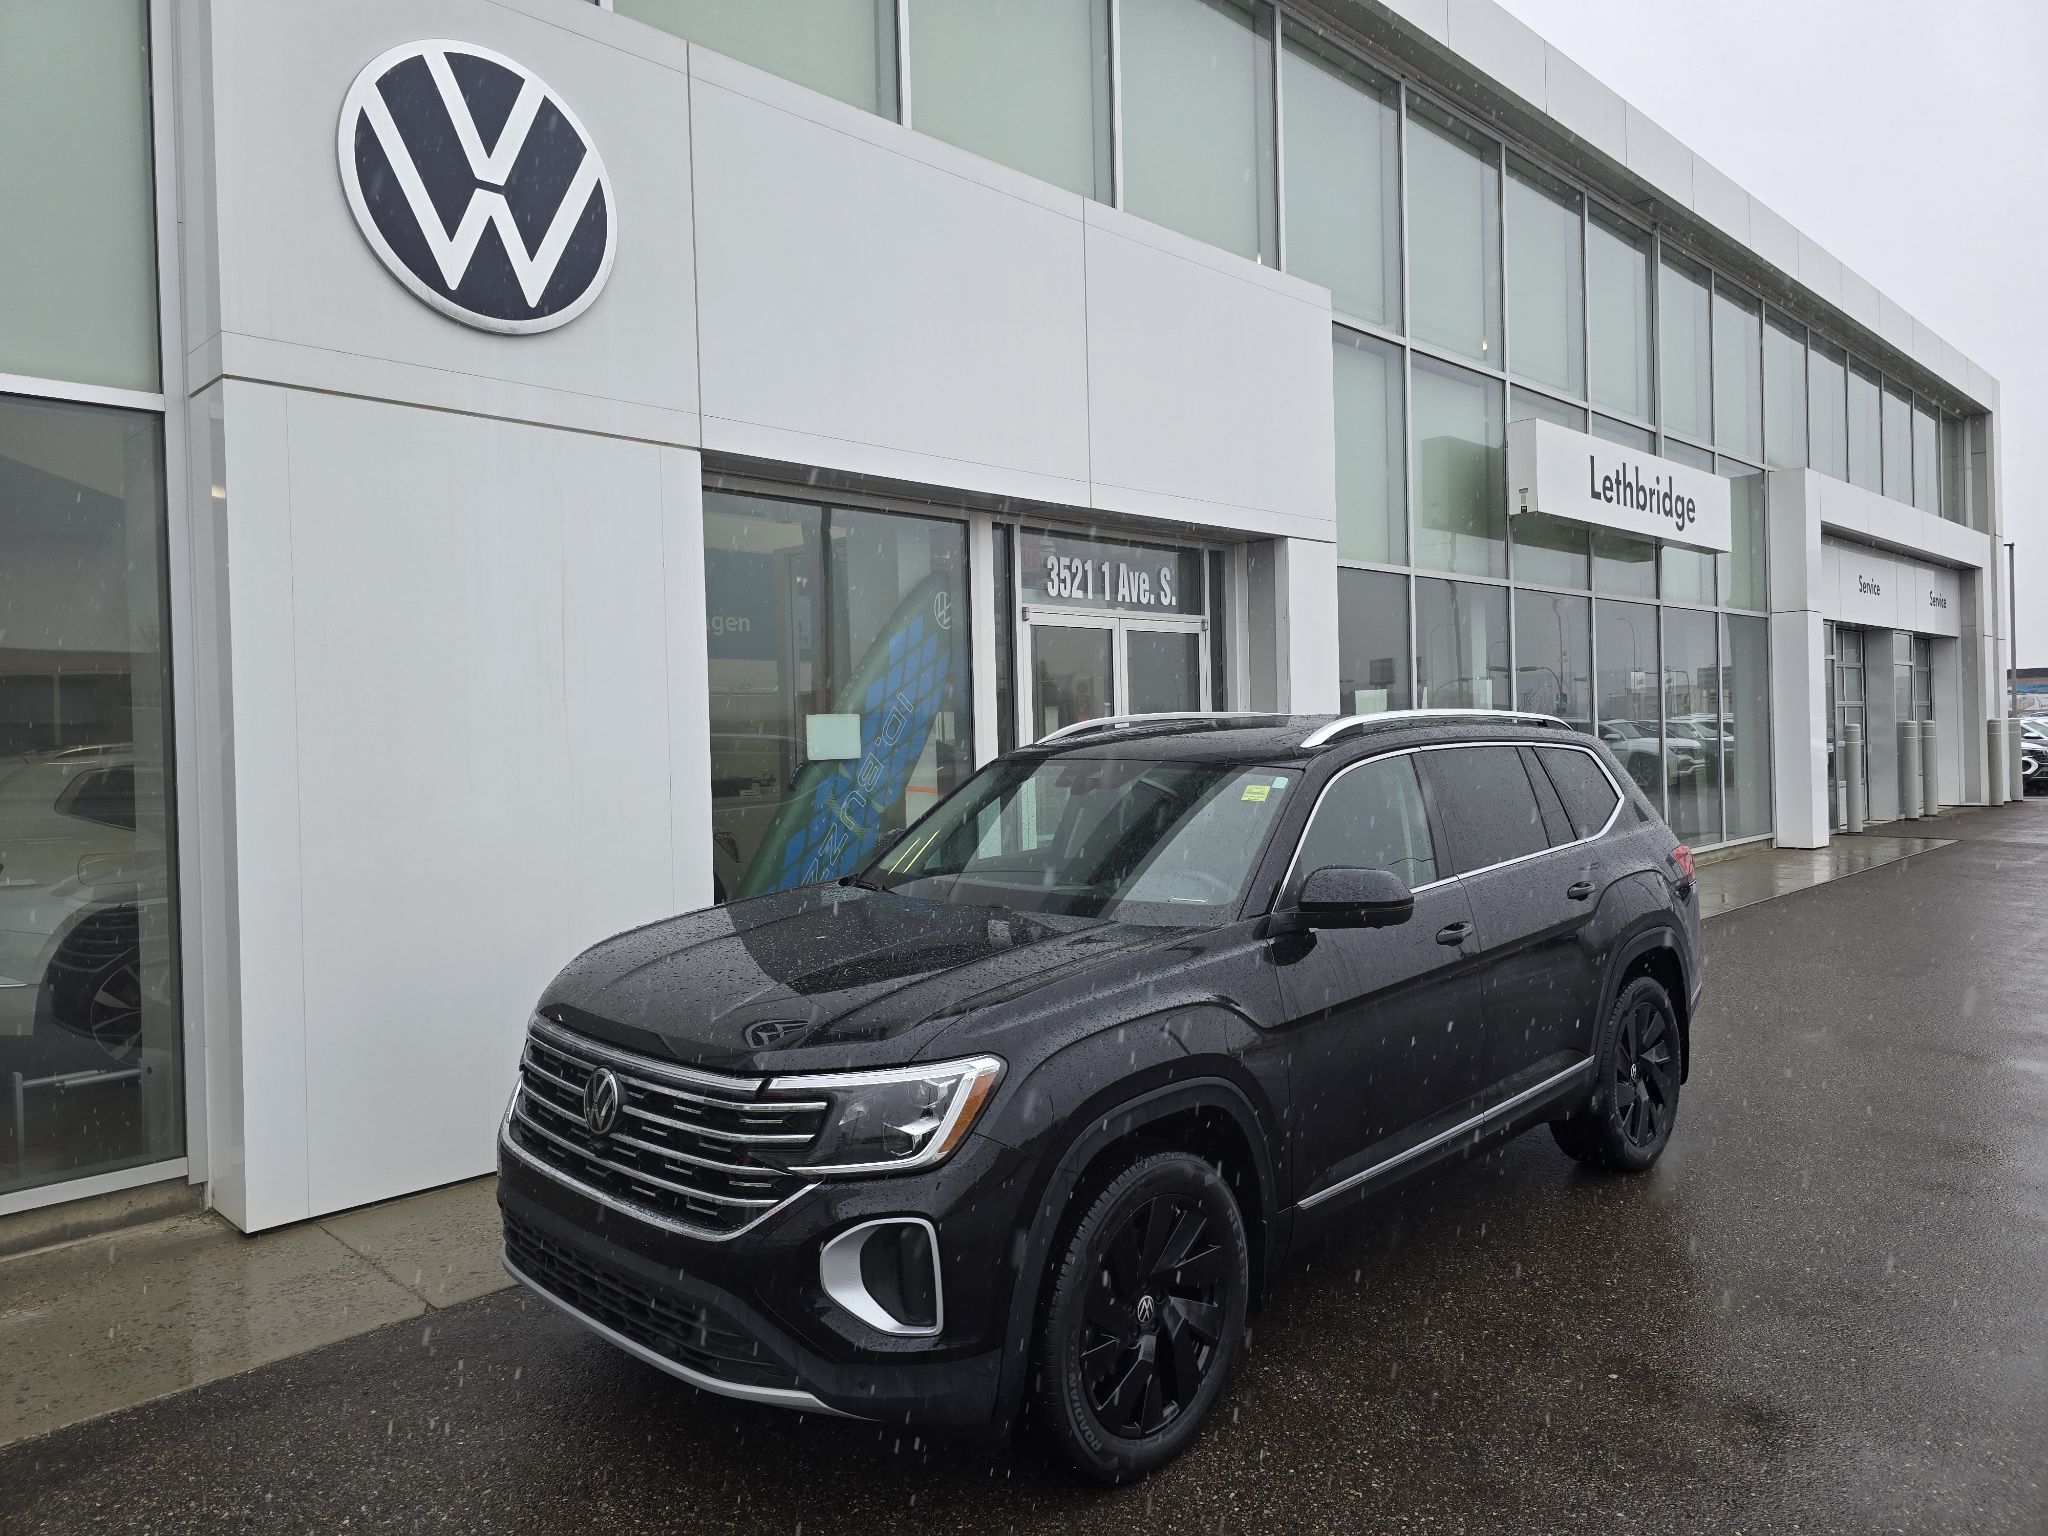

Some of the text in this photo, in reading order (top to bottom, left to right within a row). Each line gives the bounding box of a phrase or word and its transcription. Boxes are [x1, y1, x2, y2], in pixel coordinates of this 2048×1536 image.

[1589, 454, 1697, 532] Lethbridge
[1047, 555, 1177, 606] 3521 1 Ave. S.
[1858, 574, 1881, 597] Service
[1929, 590, 1947, 609] Service
